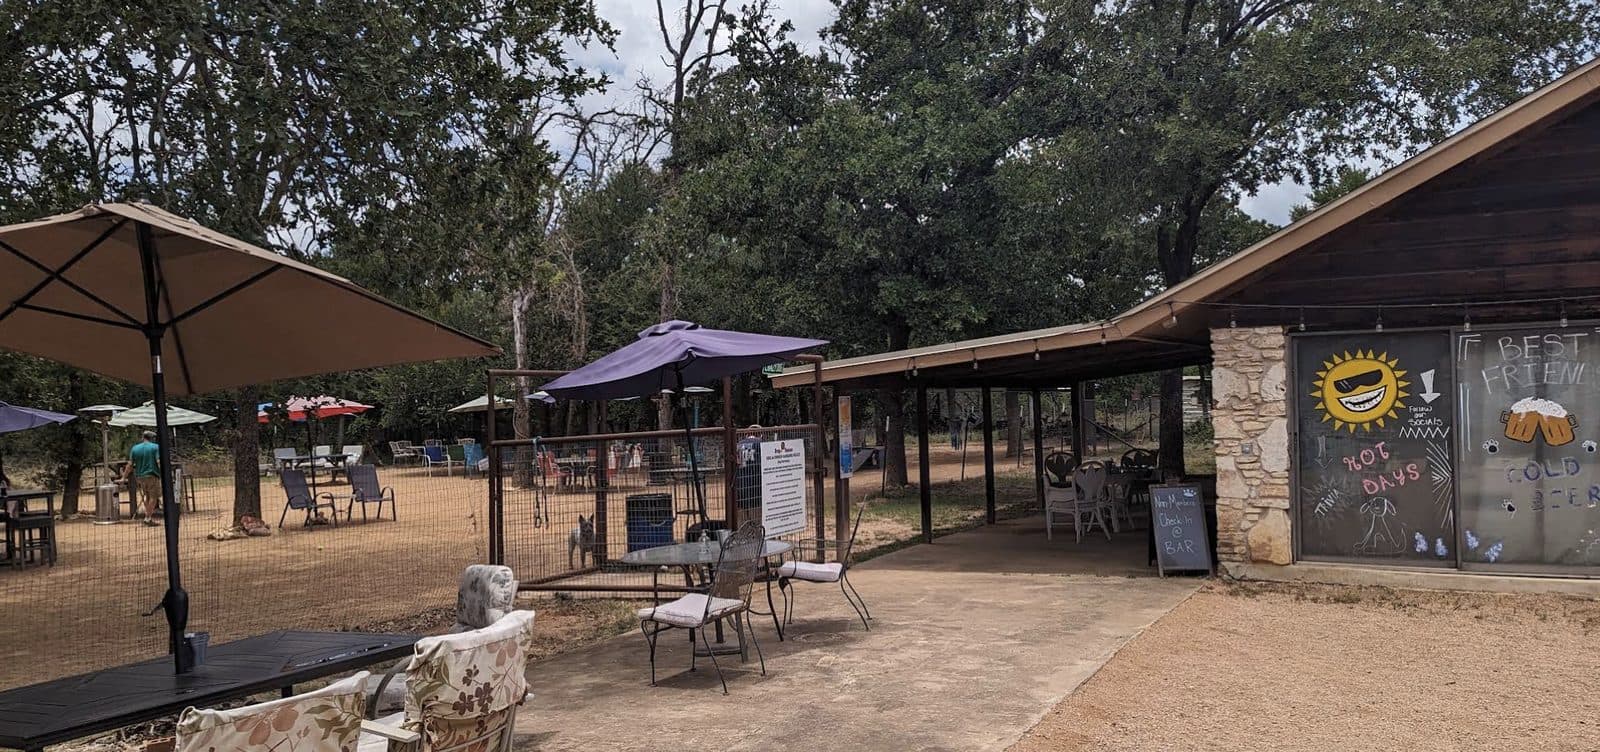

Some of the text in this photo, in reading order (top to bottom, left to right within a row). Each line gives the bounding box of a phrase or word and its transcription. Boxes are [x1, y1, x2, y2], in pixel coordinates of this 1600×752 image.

[1499, 333, 1589, 361] BEST
[1343, 441, 1389, 471] HOT
[1504, 456, 1581, 483] COLD
[1362, 463, 1420, 495] DAYS
[1172, 526, 1182, 538] @
[1164, 539, 1194, 554] BAR
